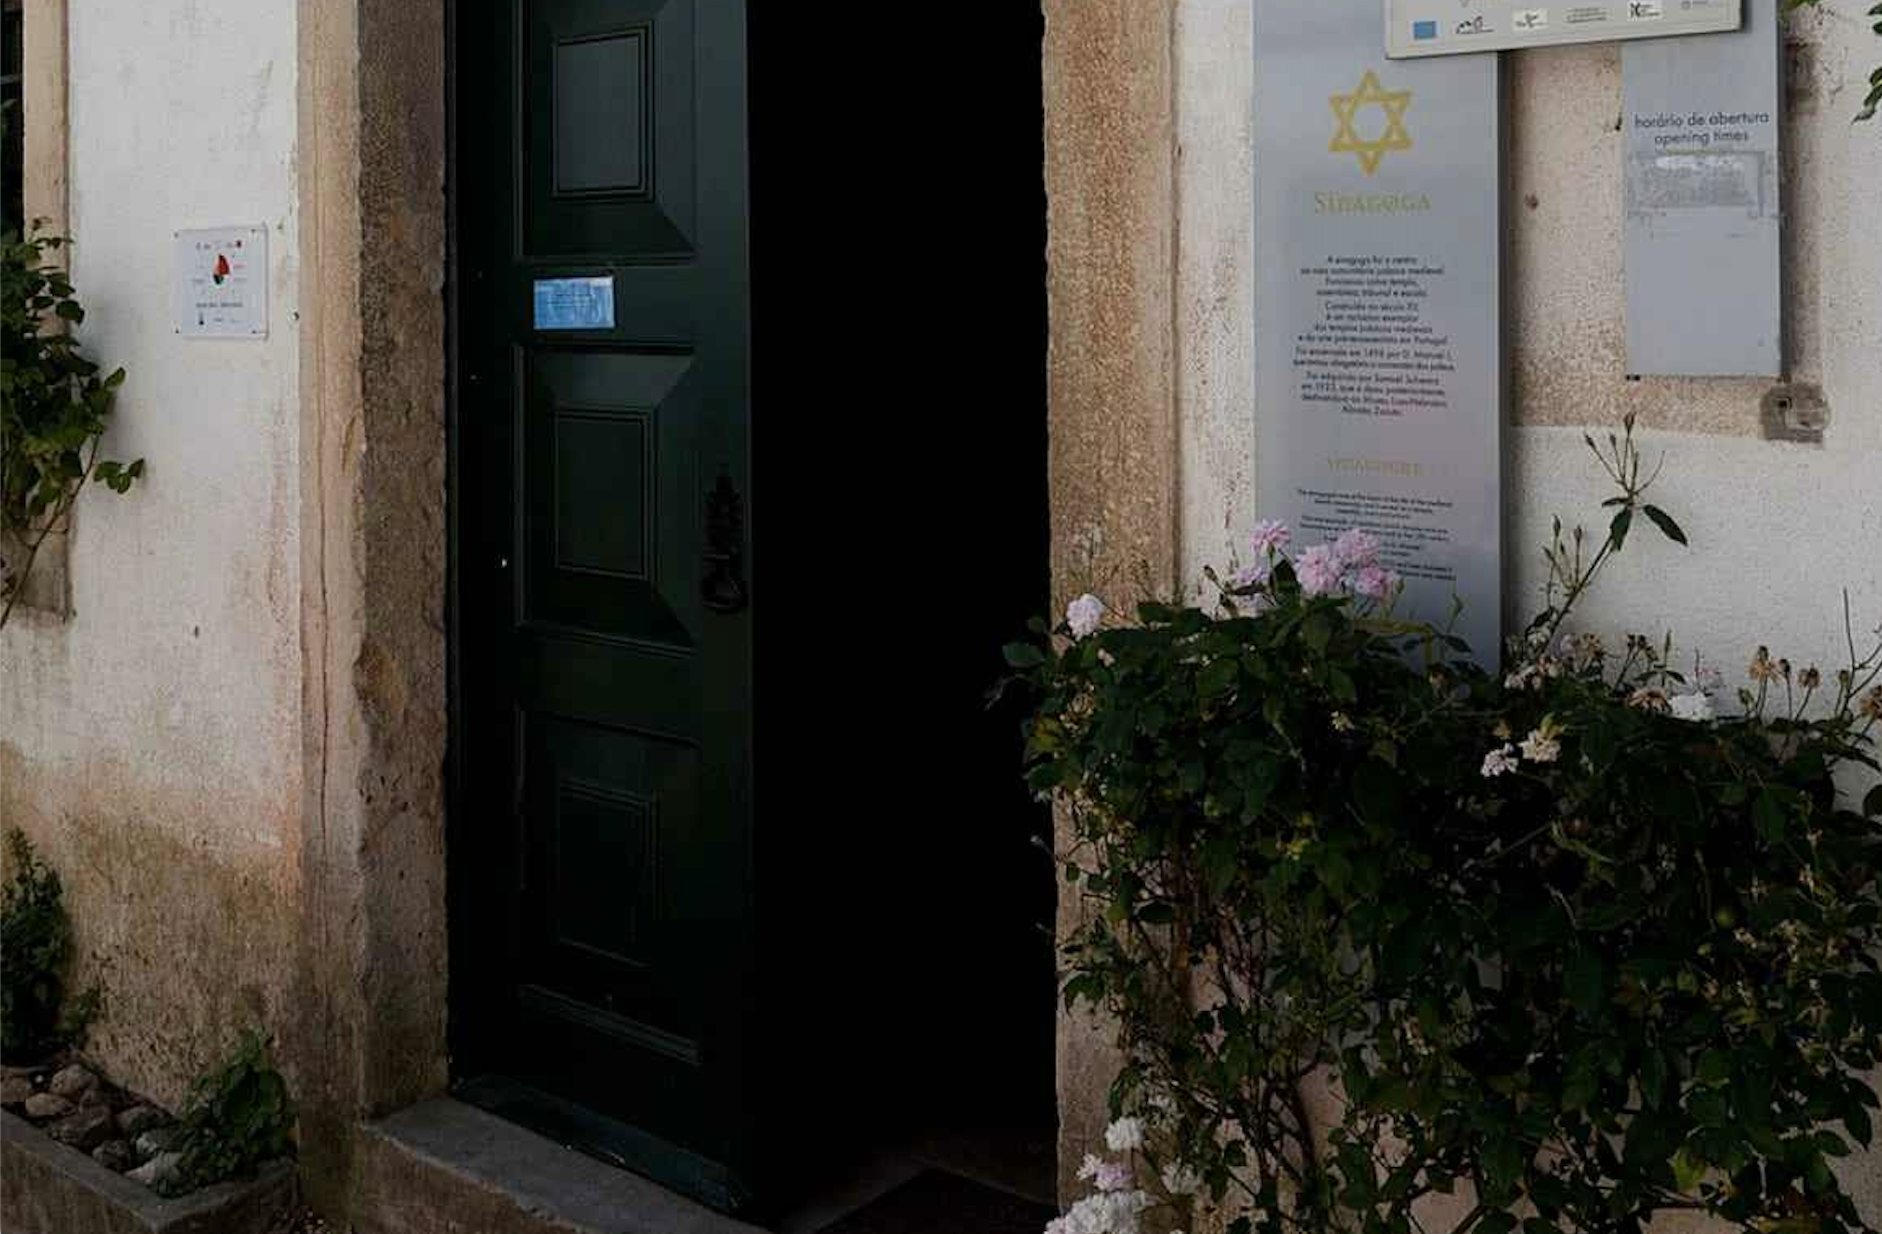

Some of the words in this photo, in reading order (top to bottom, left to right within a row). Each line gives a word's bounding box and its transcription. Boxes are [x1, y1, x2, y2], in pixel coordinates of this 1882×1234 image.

[1635, 112, 1682, 128] horário
[1687, 112, 1705, 126] de
[1709, 111, 1769, 126] abertura
[1654, 130, 1710, 147] opening
[1713, 130, 1749, 142] times
